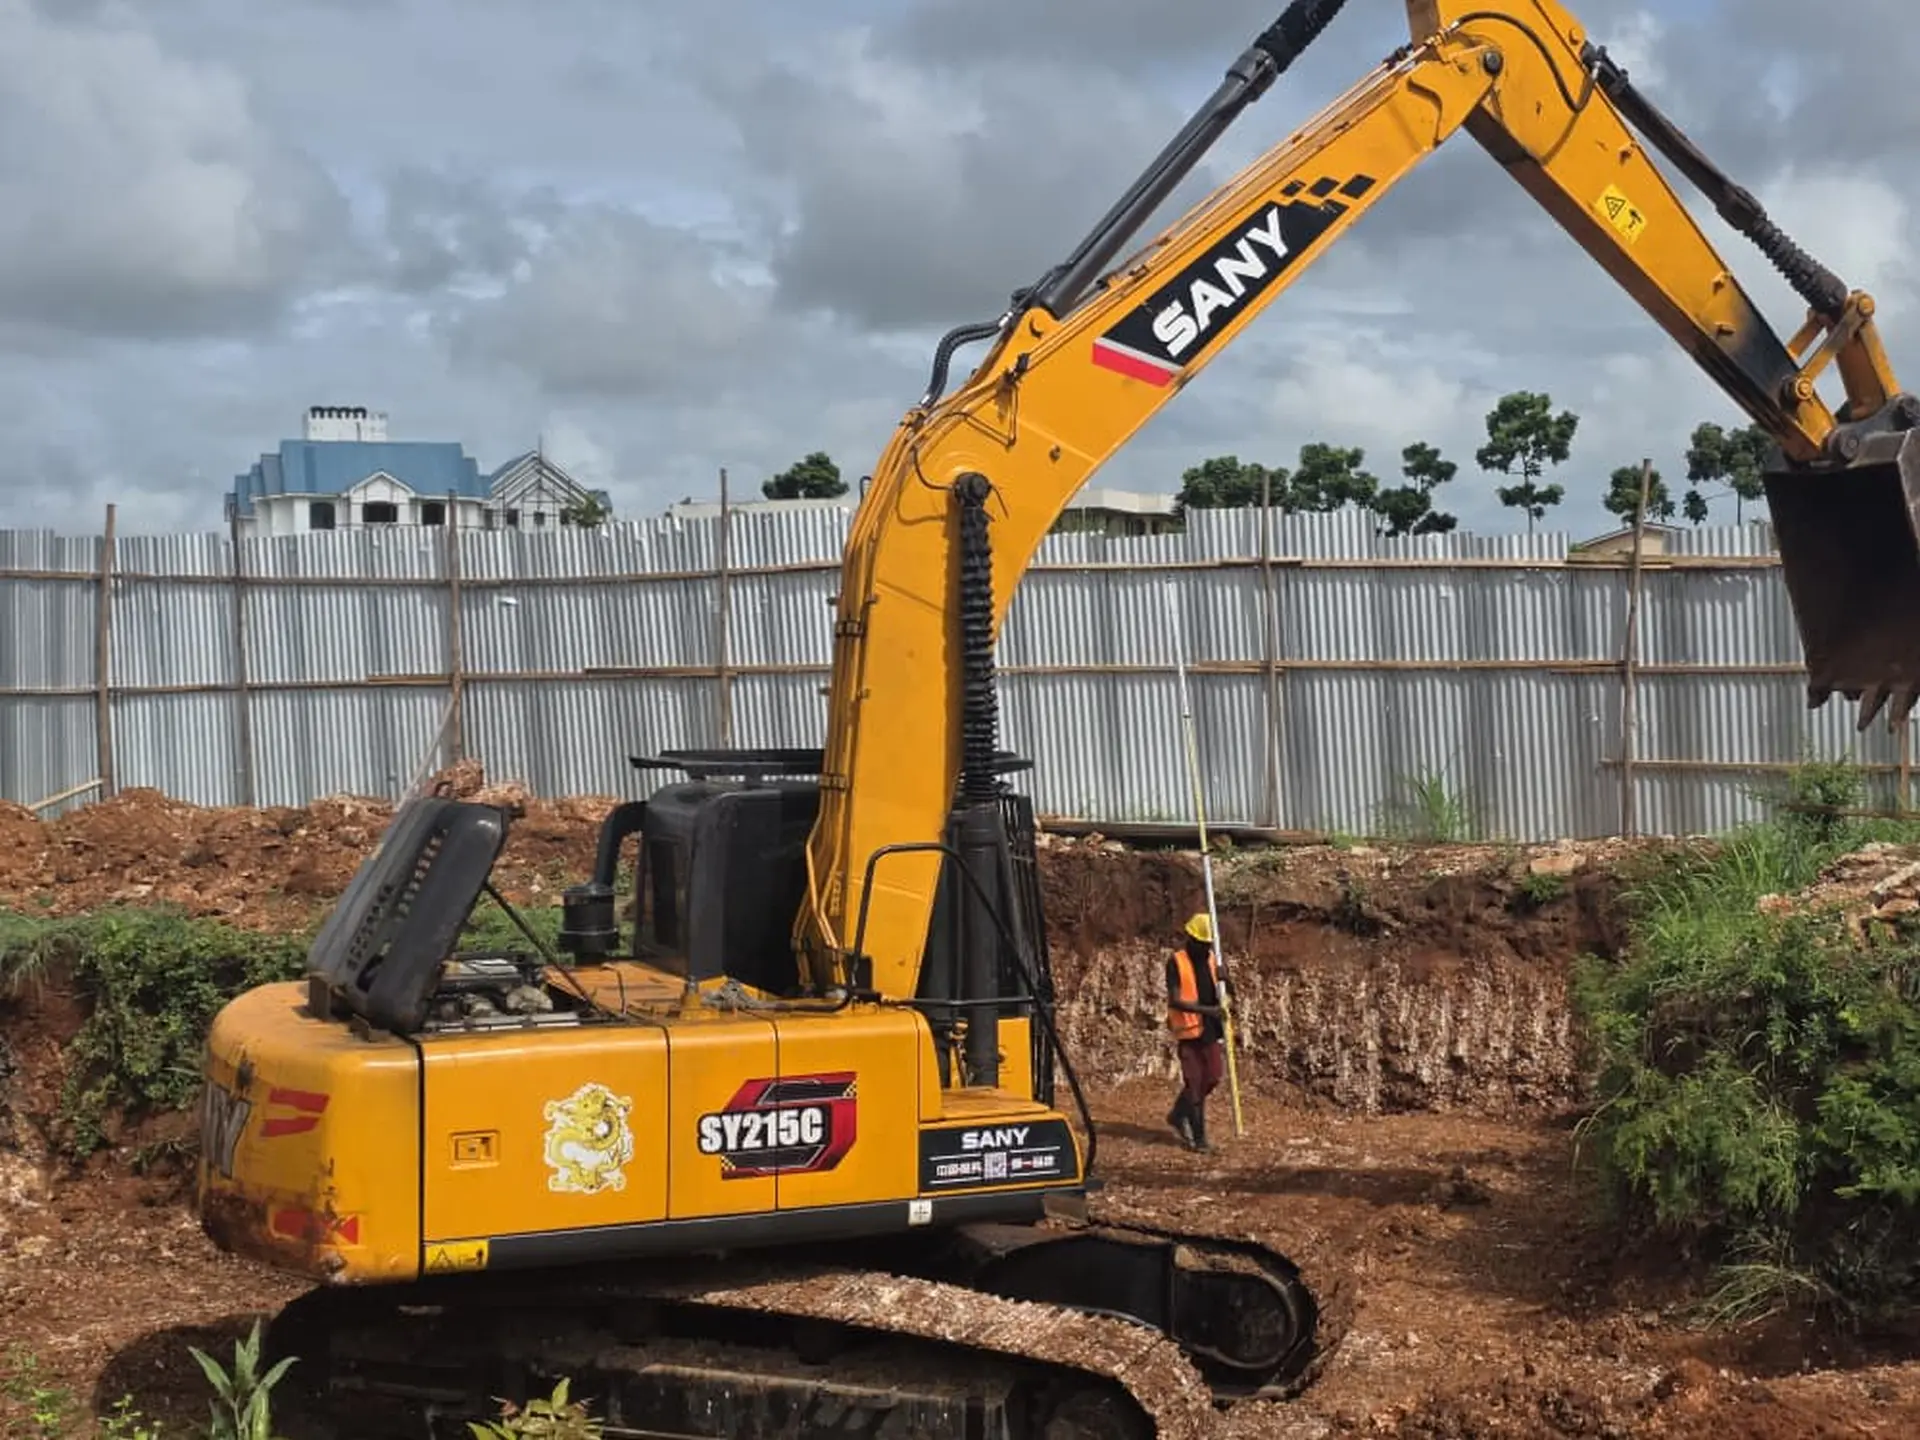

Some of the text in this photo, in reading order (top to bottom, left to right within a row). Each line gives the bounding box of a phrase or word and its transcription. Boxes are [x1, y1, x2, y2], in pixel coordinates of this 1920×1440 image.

[1152, 207, 1289, 358] SANY
[700, 1107, 823, 1153] SY215C
[961, 1127, 1030, 1149] SANY
